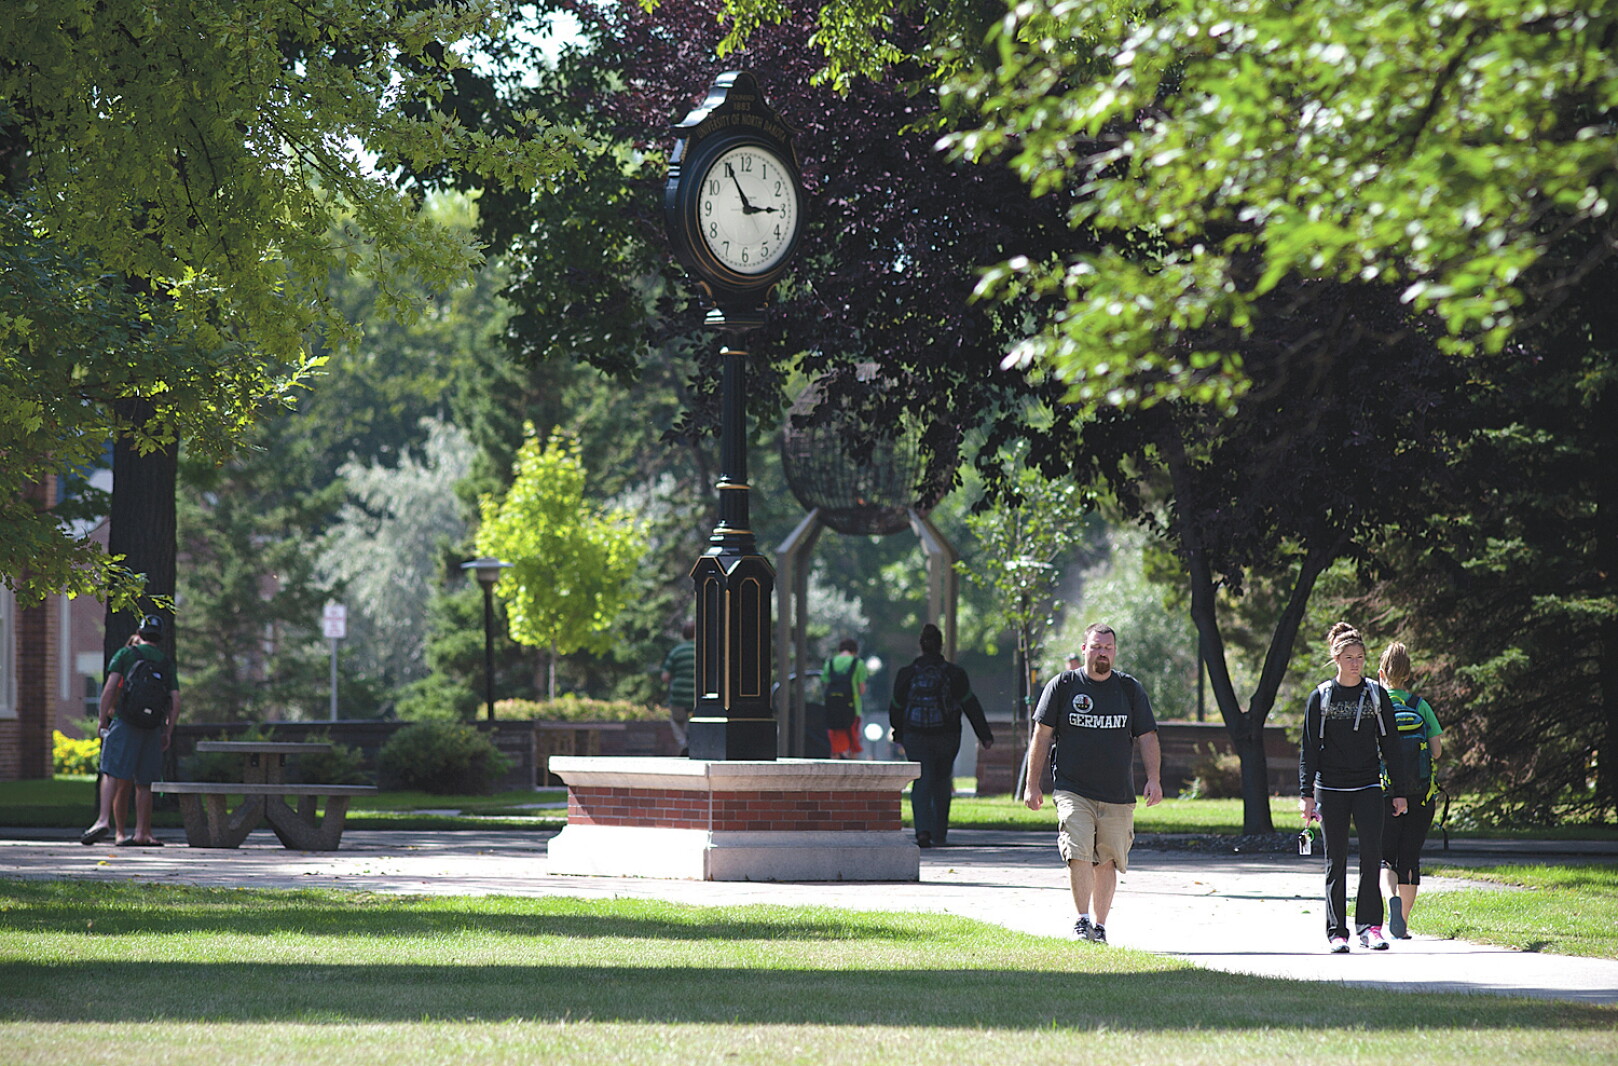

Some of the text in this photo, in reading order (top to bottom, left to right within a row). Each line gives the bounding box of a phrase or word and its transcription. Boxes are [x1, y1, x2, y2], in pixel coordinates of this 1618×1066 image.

[734, 102, 751, 110] 1883
[696, 114, 786, 142] UNIVERSITY OF NORTH DAKOTA
[740, 156, 752, 172] 12
[762, 164, 766, 180] 1
[709, 180, 720, 196] 10
[774, 181, 782, 197] 2
[705, 201, 712, 216] 9
[779, 203, 786, 219] 3
[710, 222, 718, 238] 8
[774, 224, 782, 240] 4
[722, 241, 730, 256] 7
[742, 247, 748, 262] 6
[760, 242, 769, 257] 5
[1069, 713, 1128, 728] GERMANY
